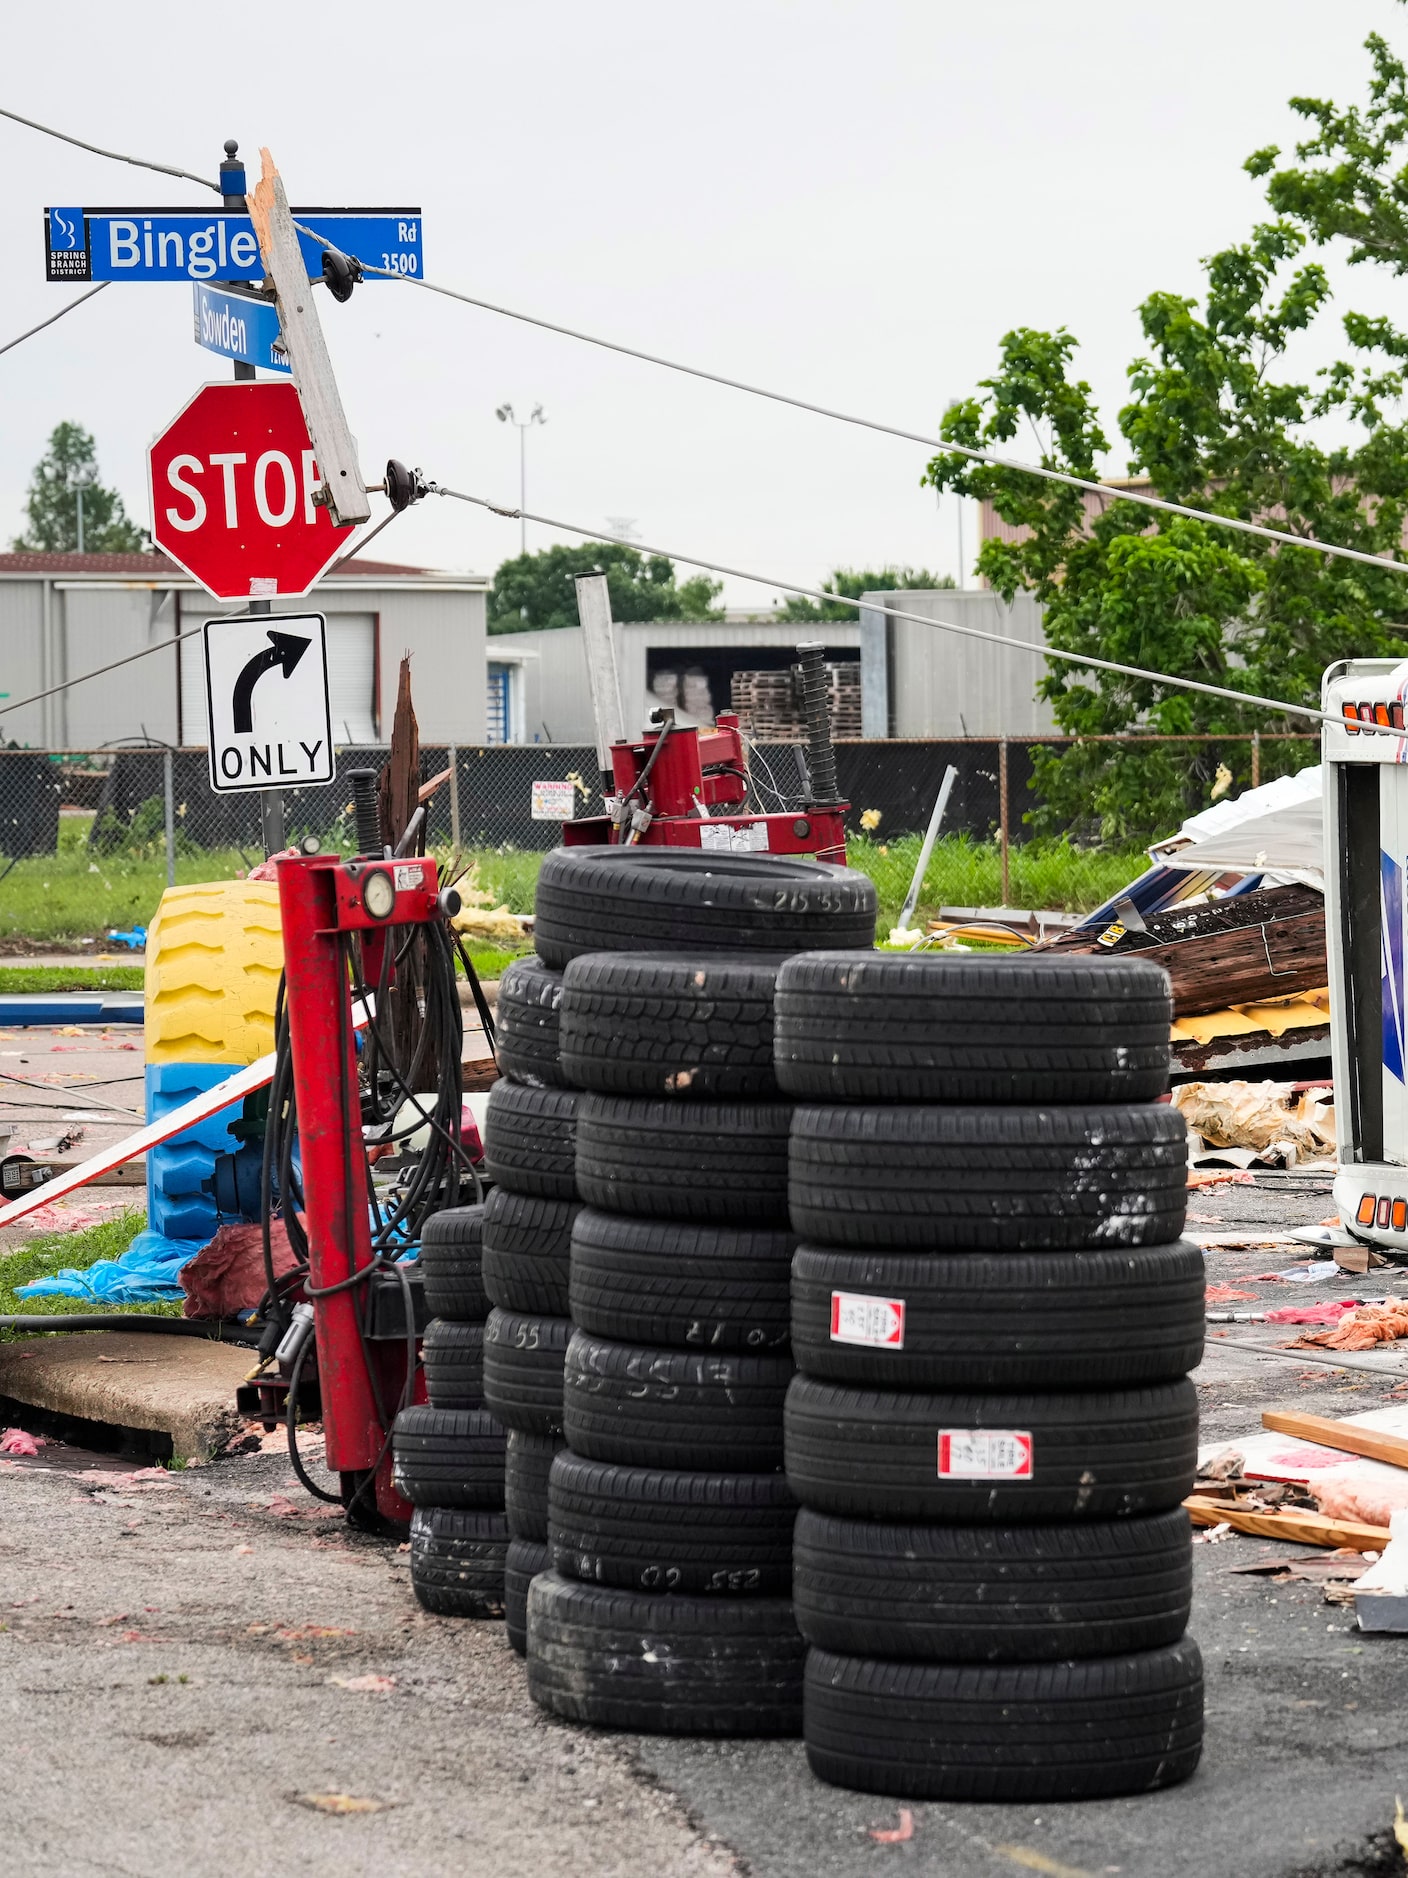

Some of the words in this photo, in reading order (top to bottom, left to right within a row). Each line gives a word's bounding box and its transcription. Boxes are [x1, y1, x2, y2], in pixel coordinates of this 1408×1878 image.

[50, 251, 87, 260] SPRING
[109, 220, 258, 279] Bingle
[398, 222, 417, 243] Rd
[50, 260, 87, 269] BRANCH
[50, 268, 87, 276] DISTRICT
[381, 252, 418, 274] 3500
[202, 295, 247, 355] Sowden
[221, 739, 324, 780] ONLY
